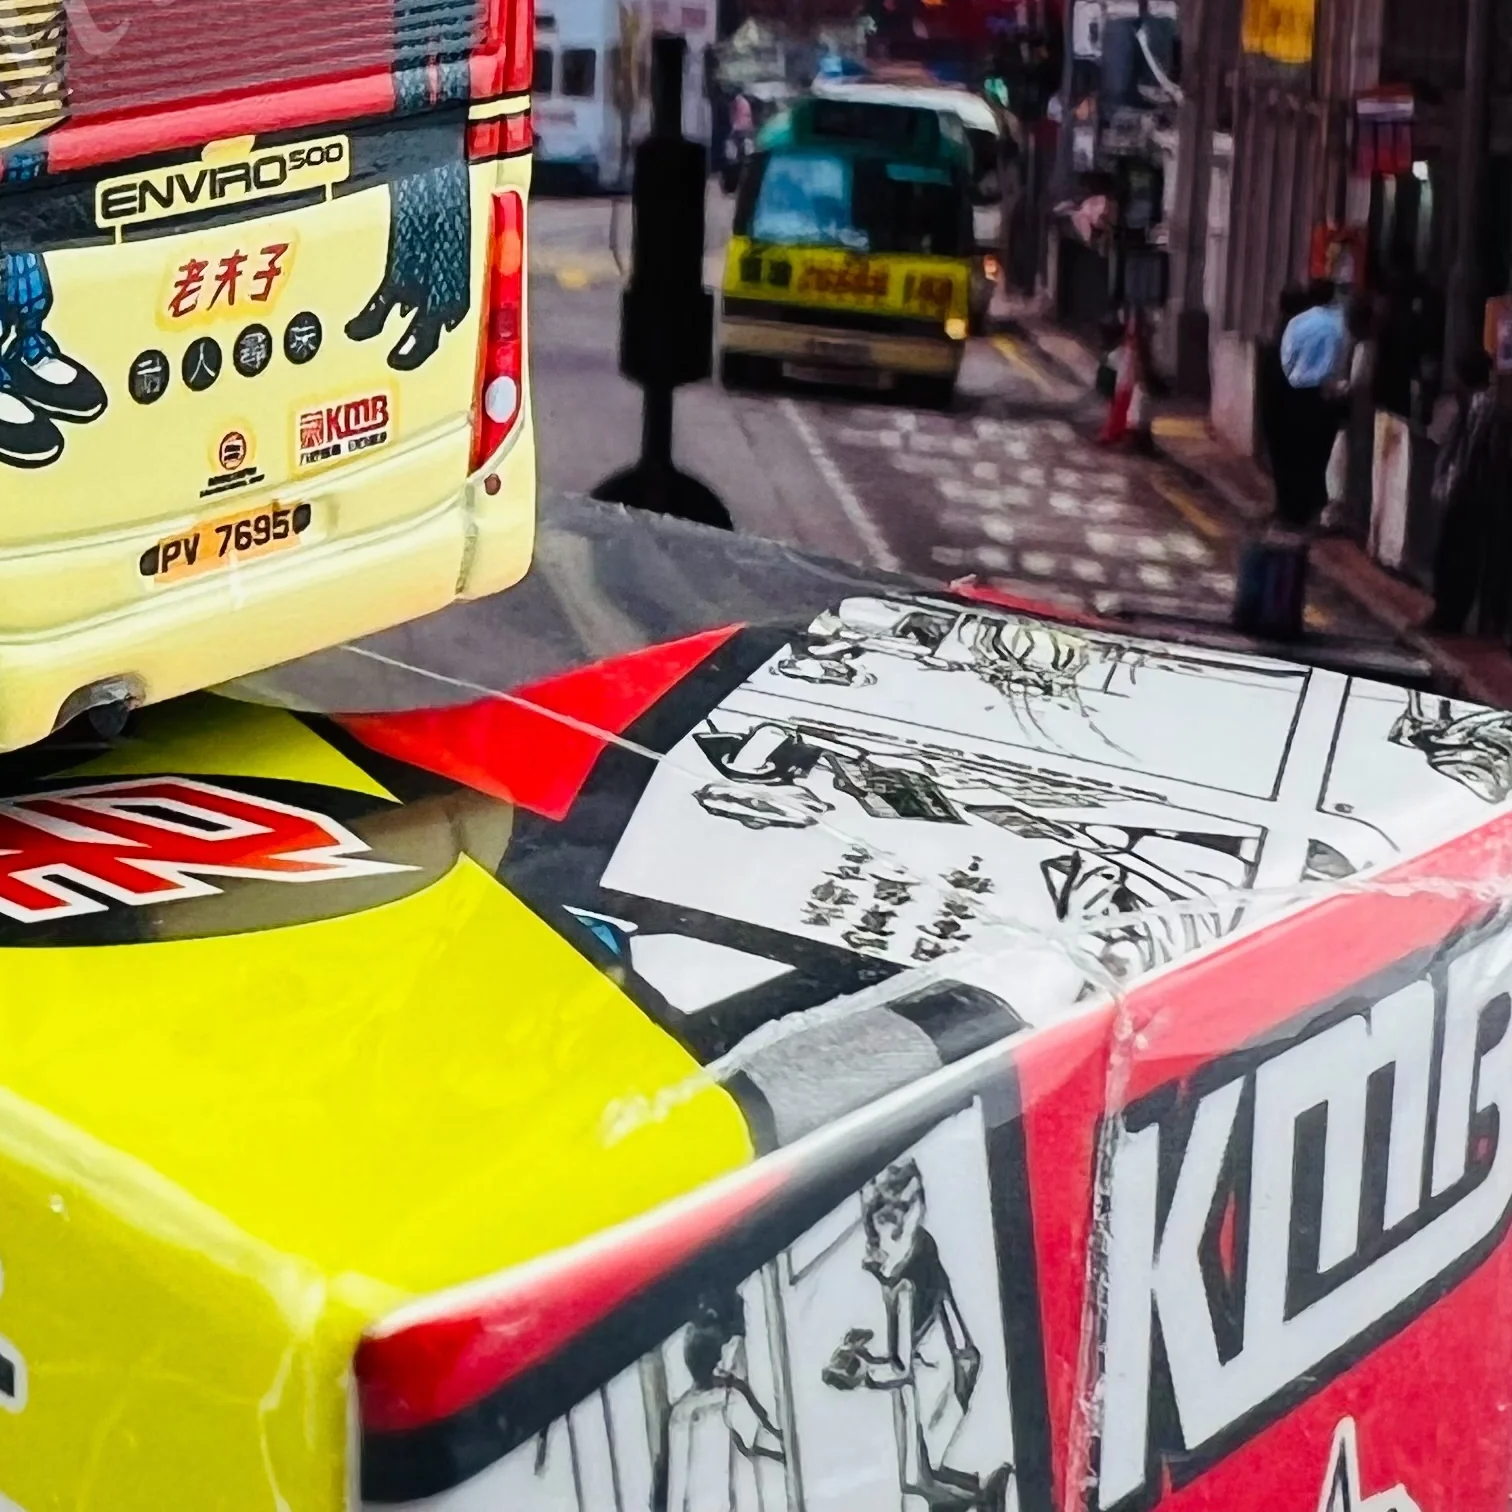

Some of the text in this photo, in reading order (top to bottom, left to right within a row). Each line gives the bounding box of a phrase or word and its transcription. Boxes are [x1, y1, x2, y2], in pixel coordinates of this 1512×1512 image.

[168, 242, 290, 318] 老夫子
[161, 509, 290, 573] PV 7695
